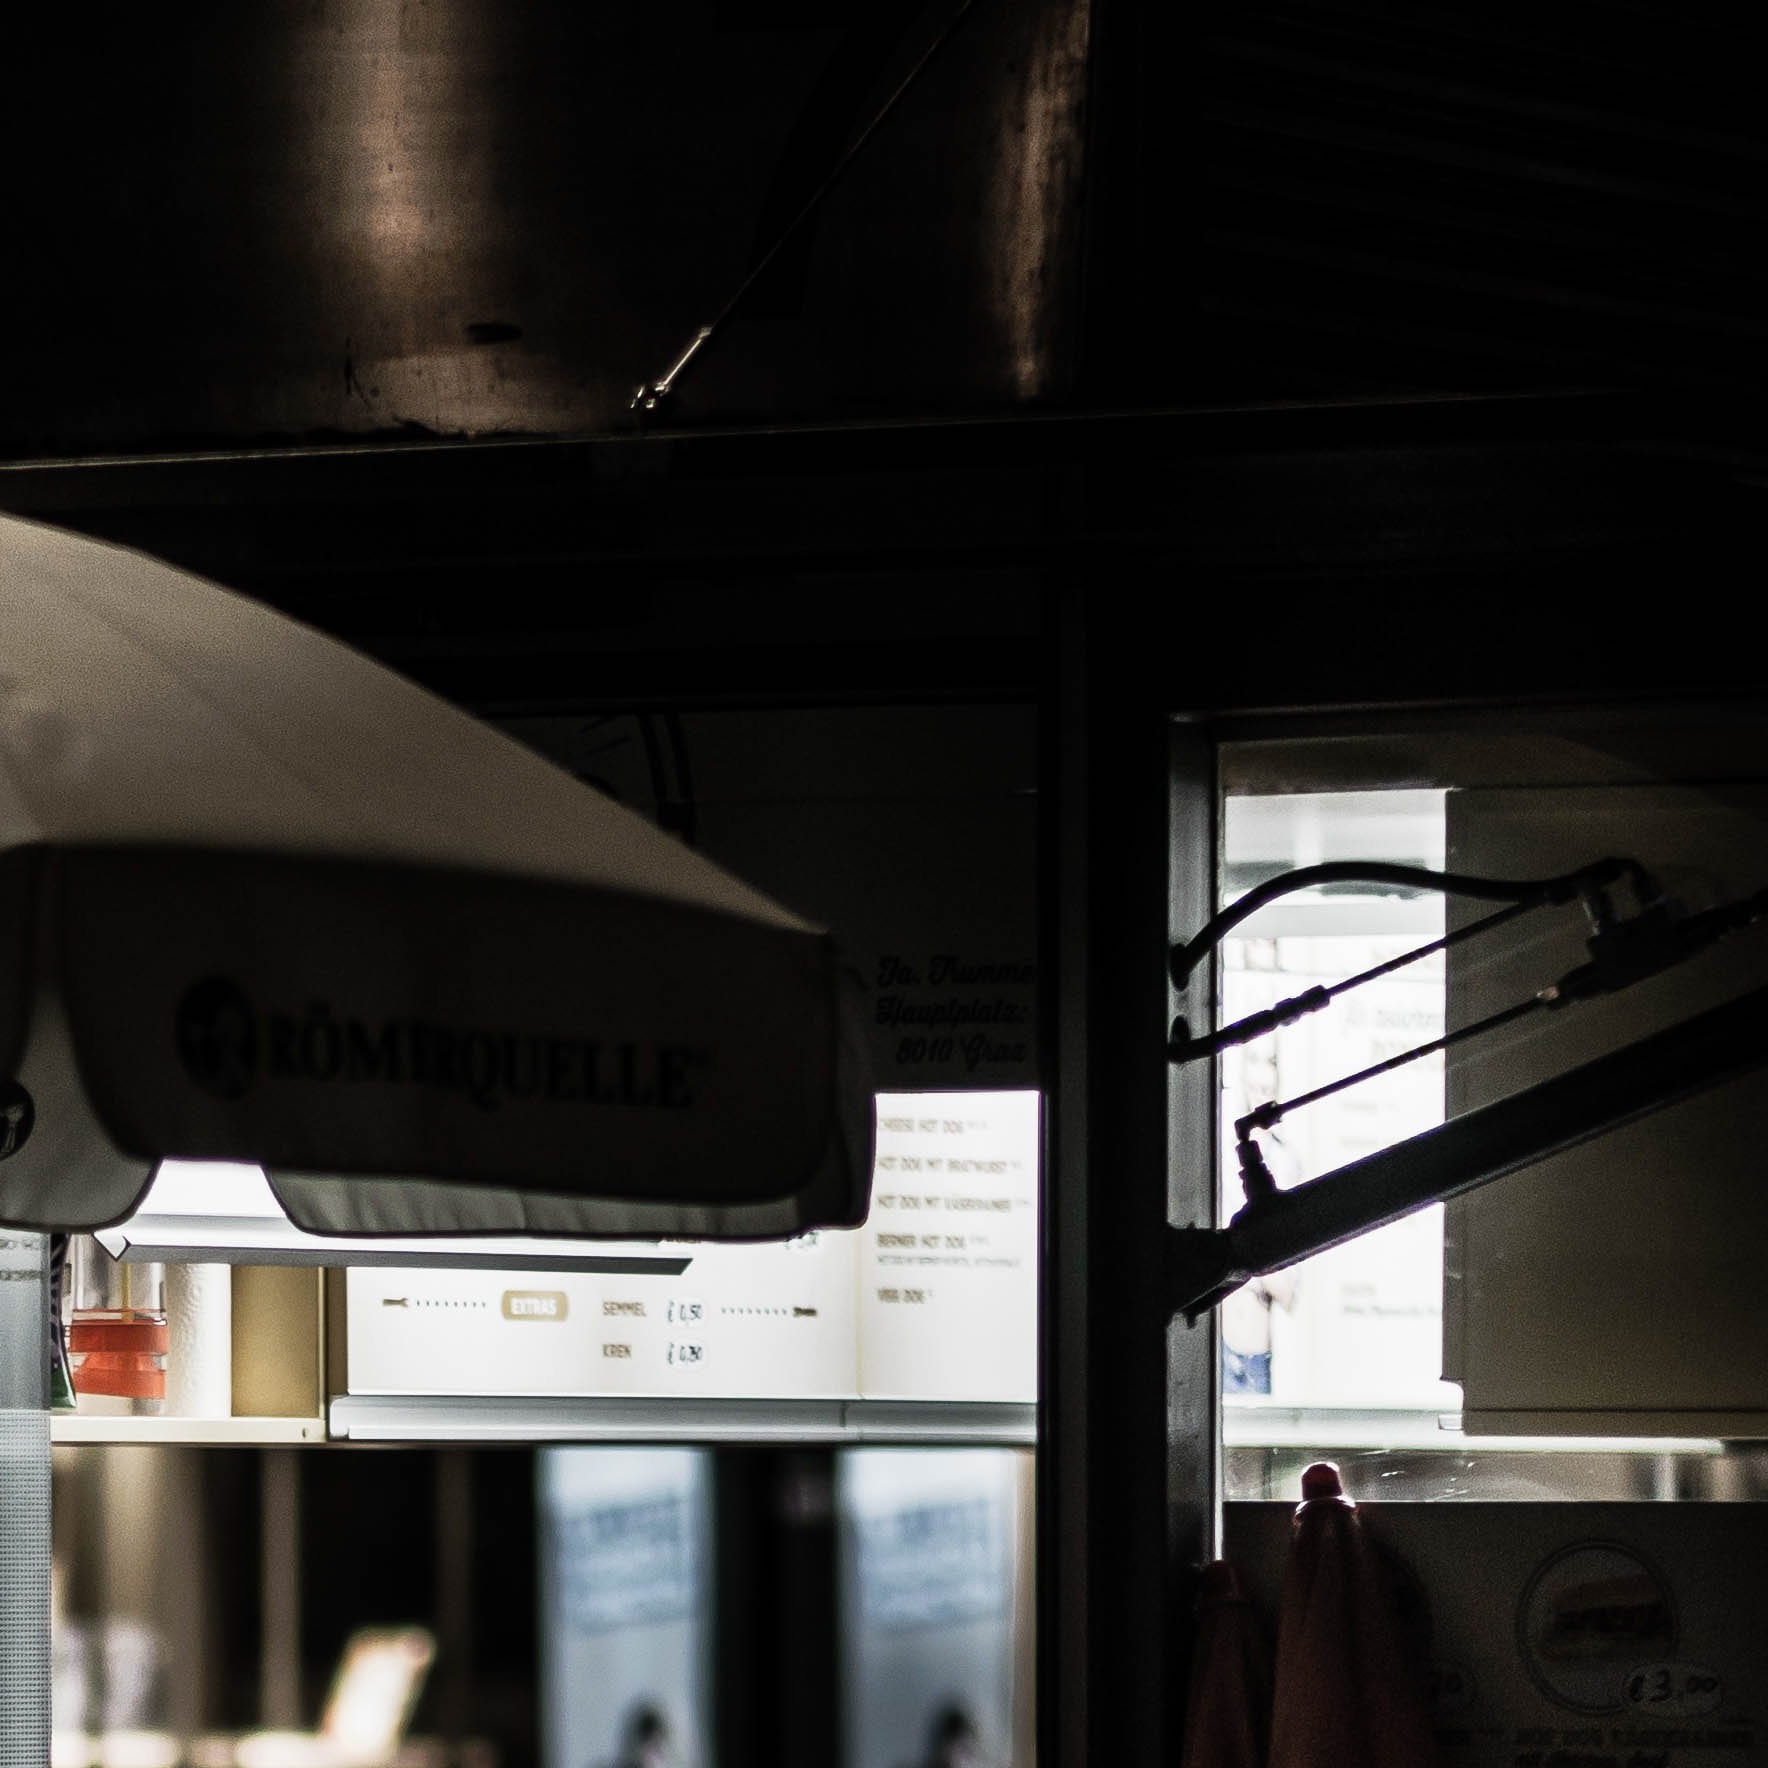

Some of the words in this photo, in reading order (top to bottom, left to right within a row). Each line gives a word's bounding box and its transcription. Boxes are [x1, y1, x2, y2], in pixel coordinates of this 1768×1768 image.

[269, 1002, 698, 1112] RÖMERQUELLE
[602, 1299, 647, 1318] SEMMEL
[602, 1343, 632, 1359] KREN
